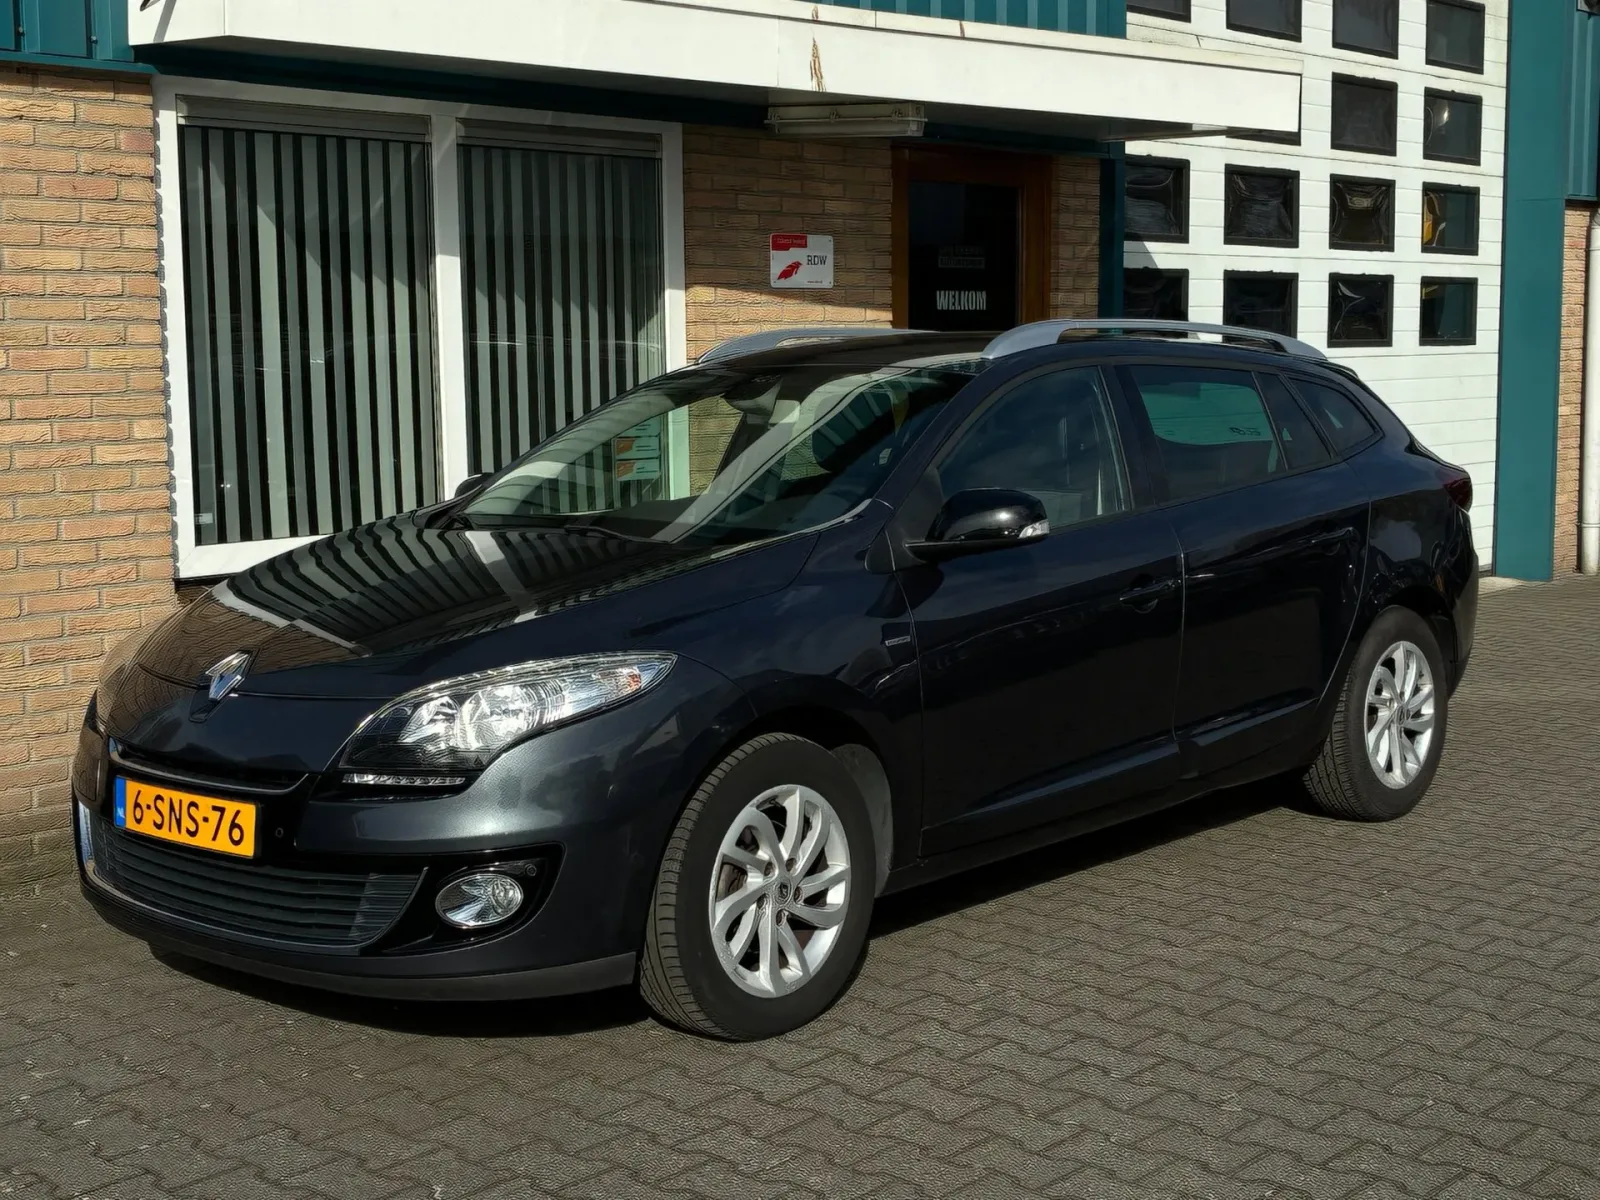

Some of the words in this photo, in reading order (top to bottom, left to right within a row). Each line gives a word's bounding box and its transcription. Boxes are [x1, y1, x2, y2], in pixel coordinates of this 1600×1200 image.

[807, 255, 827, 266] RDW
[936, 290, 987, 311] WELKOM
[132, 790, 245, 847] 6-SNS-76
